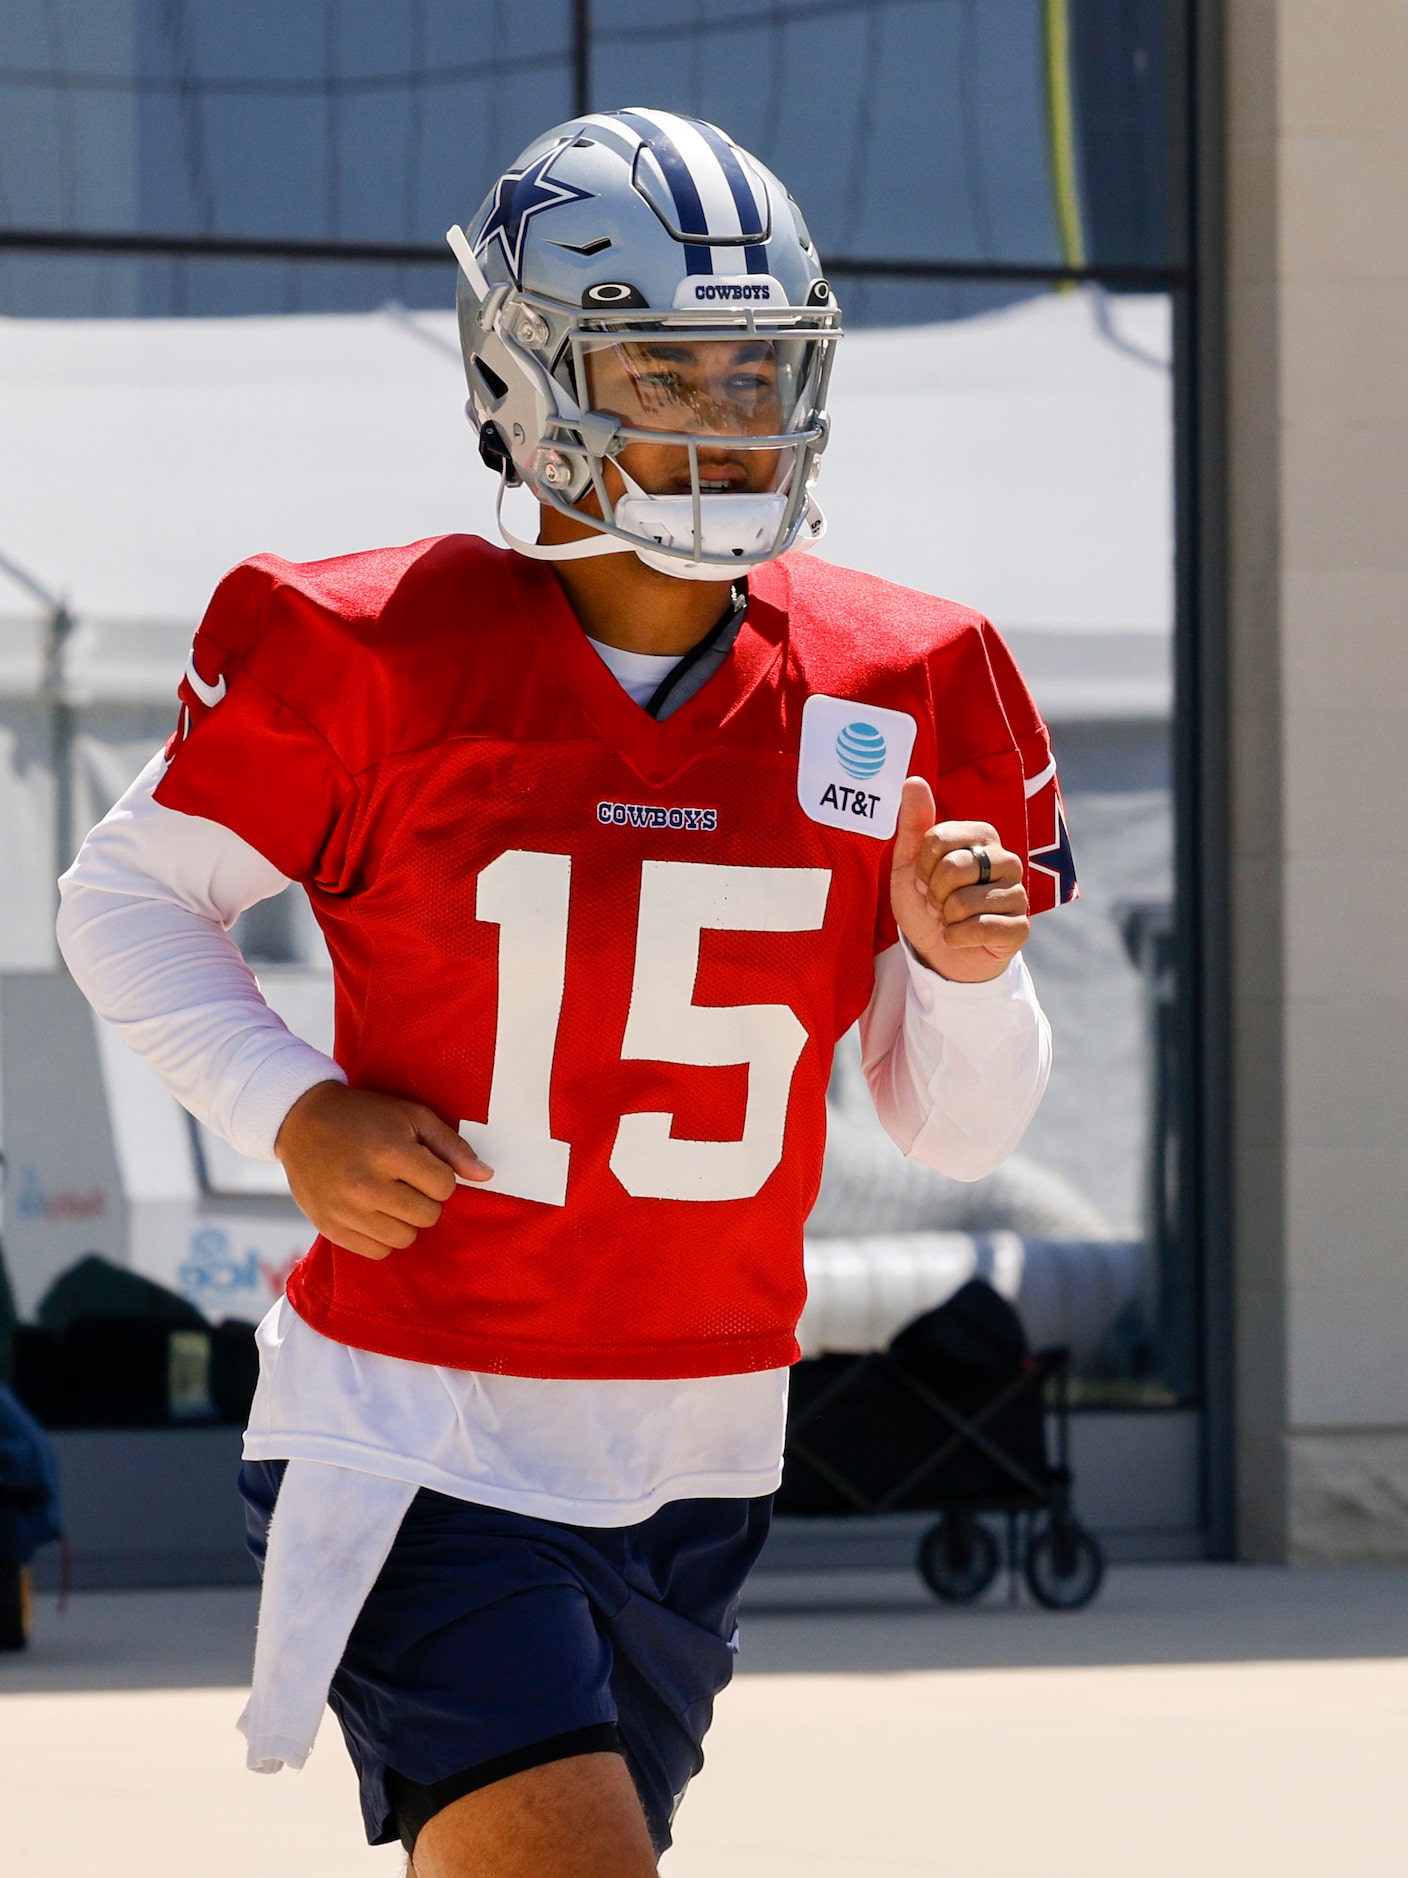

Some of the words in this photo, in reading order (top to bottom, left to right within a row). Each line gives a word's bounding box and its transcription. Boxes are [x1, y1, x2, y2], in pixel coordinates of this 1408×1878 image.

[694, 285, 770, 300] COWBOYS
[597, 801, 718, 831] COWBOYS
[819, 783, 881, 819] AT&T
[456, 849, 832, 1208] 15
